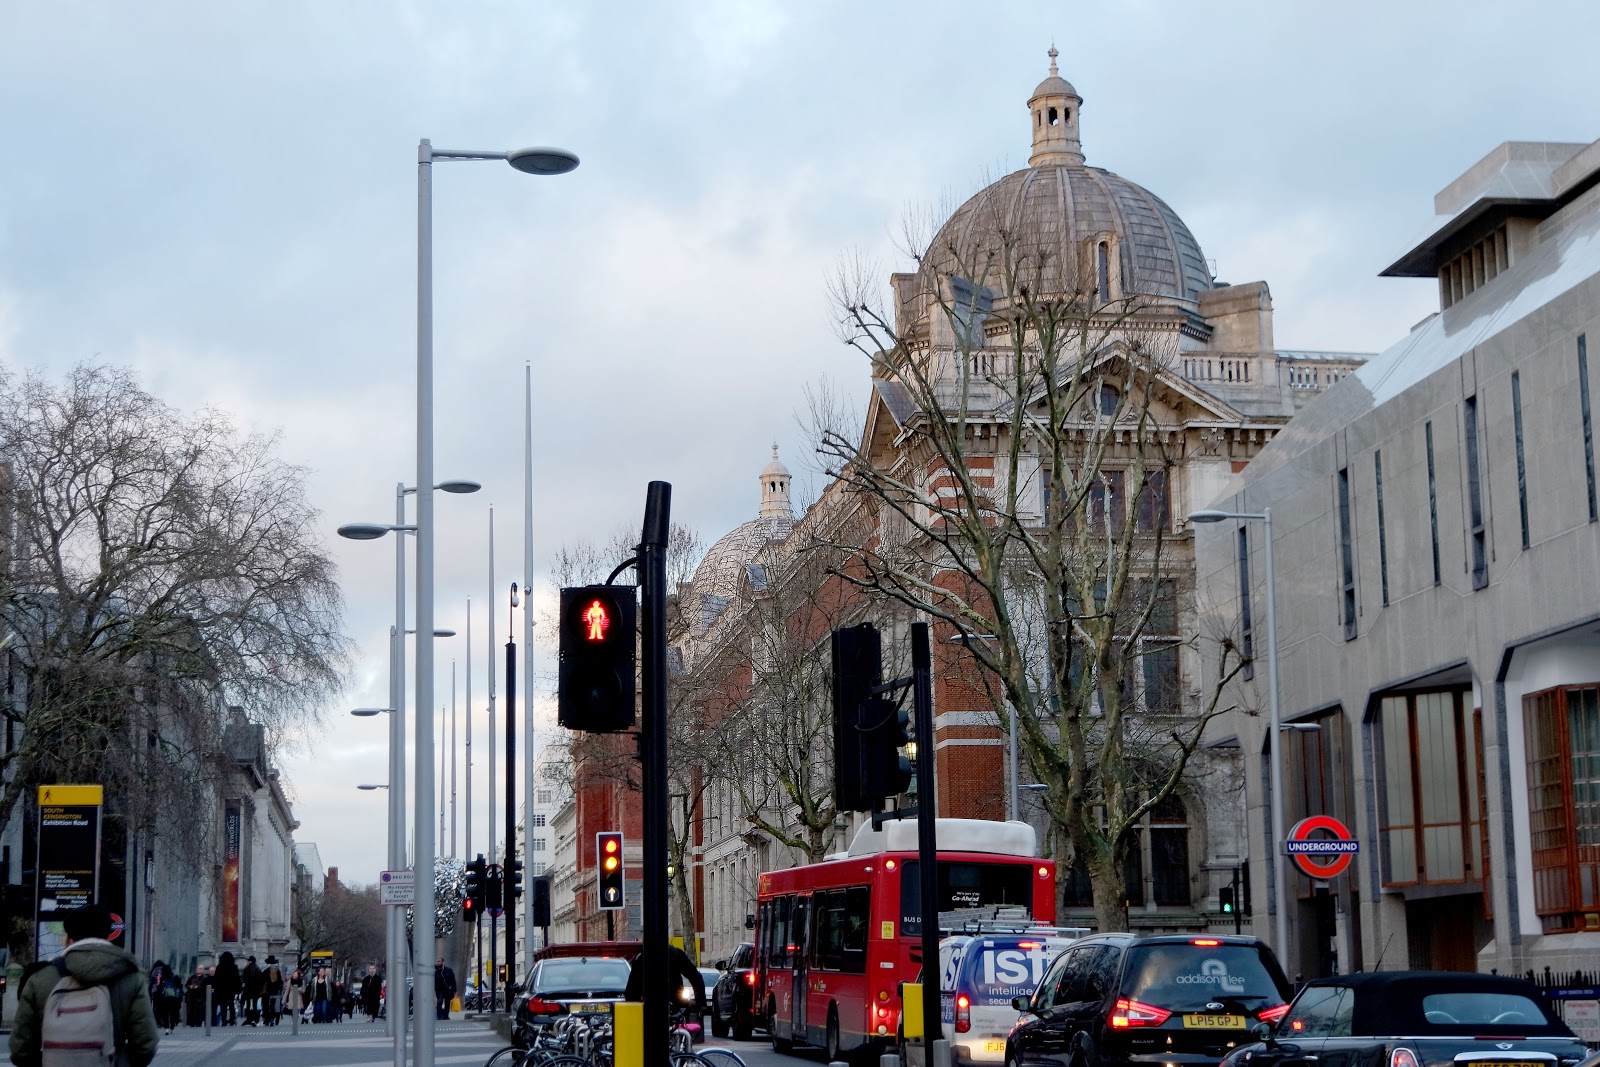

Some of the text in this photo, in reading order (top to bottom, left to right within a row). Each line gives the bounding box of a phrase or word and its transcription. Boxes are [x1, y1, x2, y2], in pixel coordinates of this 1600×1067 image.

[1288, 843, 1358, 851] UNDERGROUND
[1176, 974, 1245, 984] addison lee
[988, 987, 1033, 996] intellige
[1190, 1016, 1214, 1026] LP15
[987, 1043, 1004, 1051] FJ6
